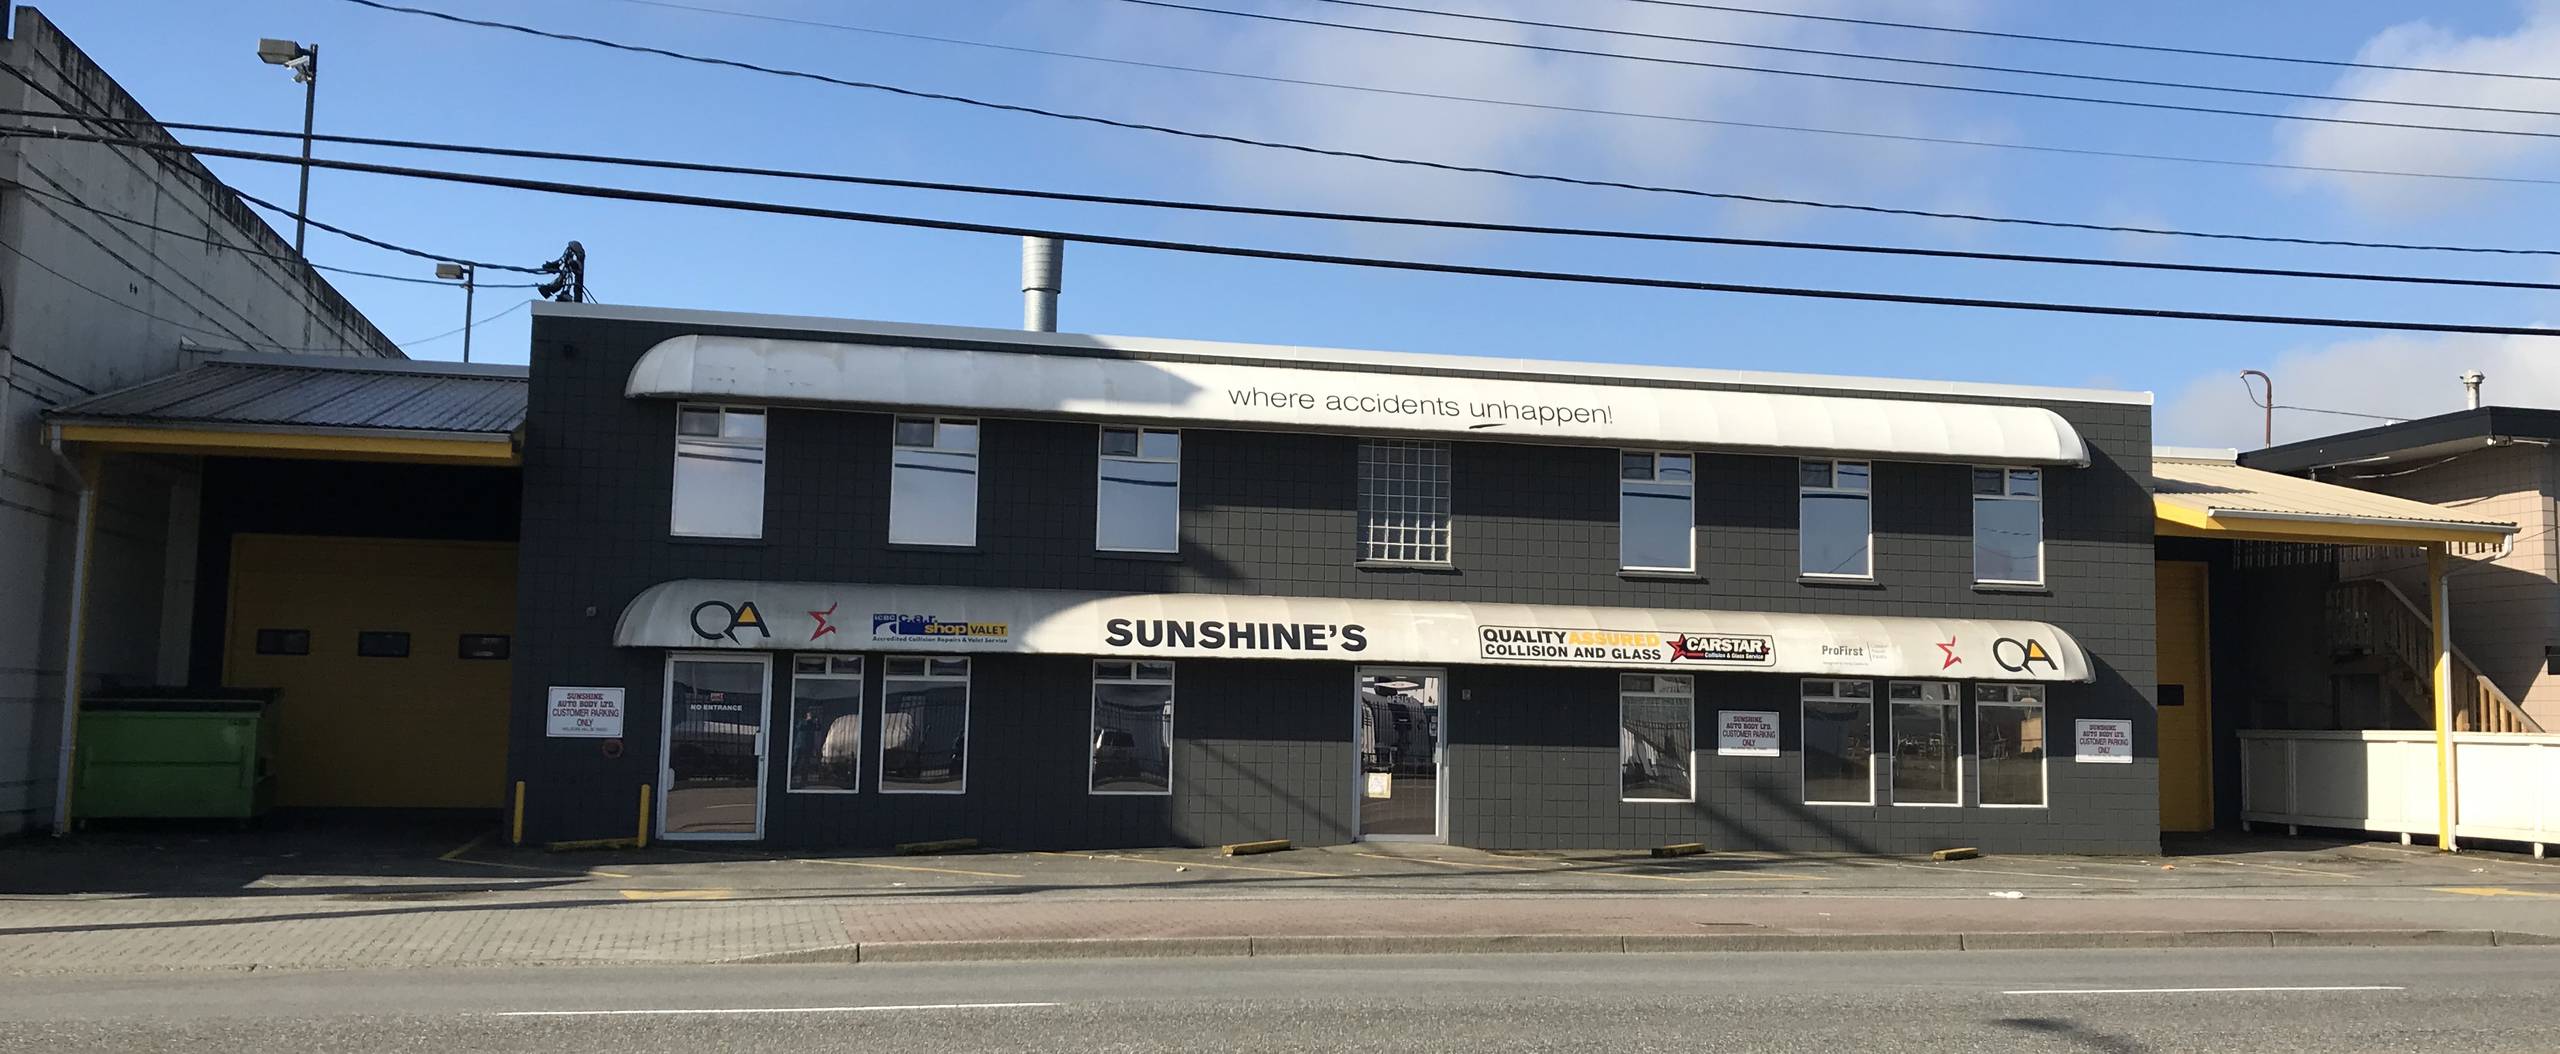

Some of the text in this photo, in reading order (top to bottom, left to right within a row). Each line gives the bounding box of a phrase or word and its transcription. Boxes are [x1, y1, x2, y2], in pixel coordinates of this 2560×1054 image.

[1228, 387, 1613, 426] where accidents unhappen!
[690, 600, 771, 645] QA
[924, 623, 1007, 635] shop VALET
[937, 636, 961, 644] Repairs
[1105, 618, 1368, 652] SUNSHINE'S
[1483, 628, 1660, 648] QUALITY ASSURED
[1485, 644, 1661, 661] COLLISION AND GLASS
[1686, 638, 1762, 653] CARSTAR
[1822, 645, 1863, 656] ProFirst
[1992, 637, 2059, 676] QA
[552, 708, 619, 717] CUSTOMER PARKING
[1723, 730, 1752, 738] CUSTOMER
